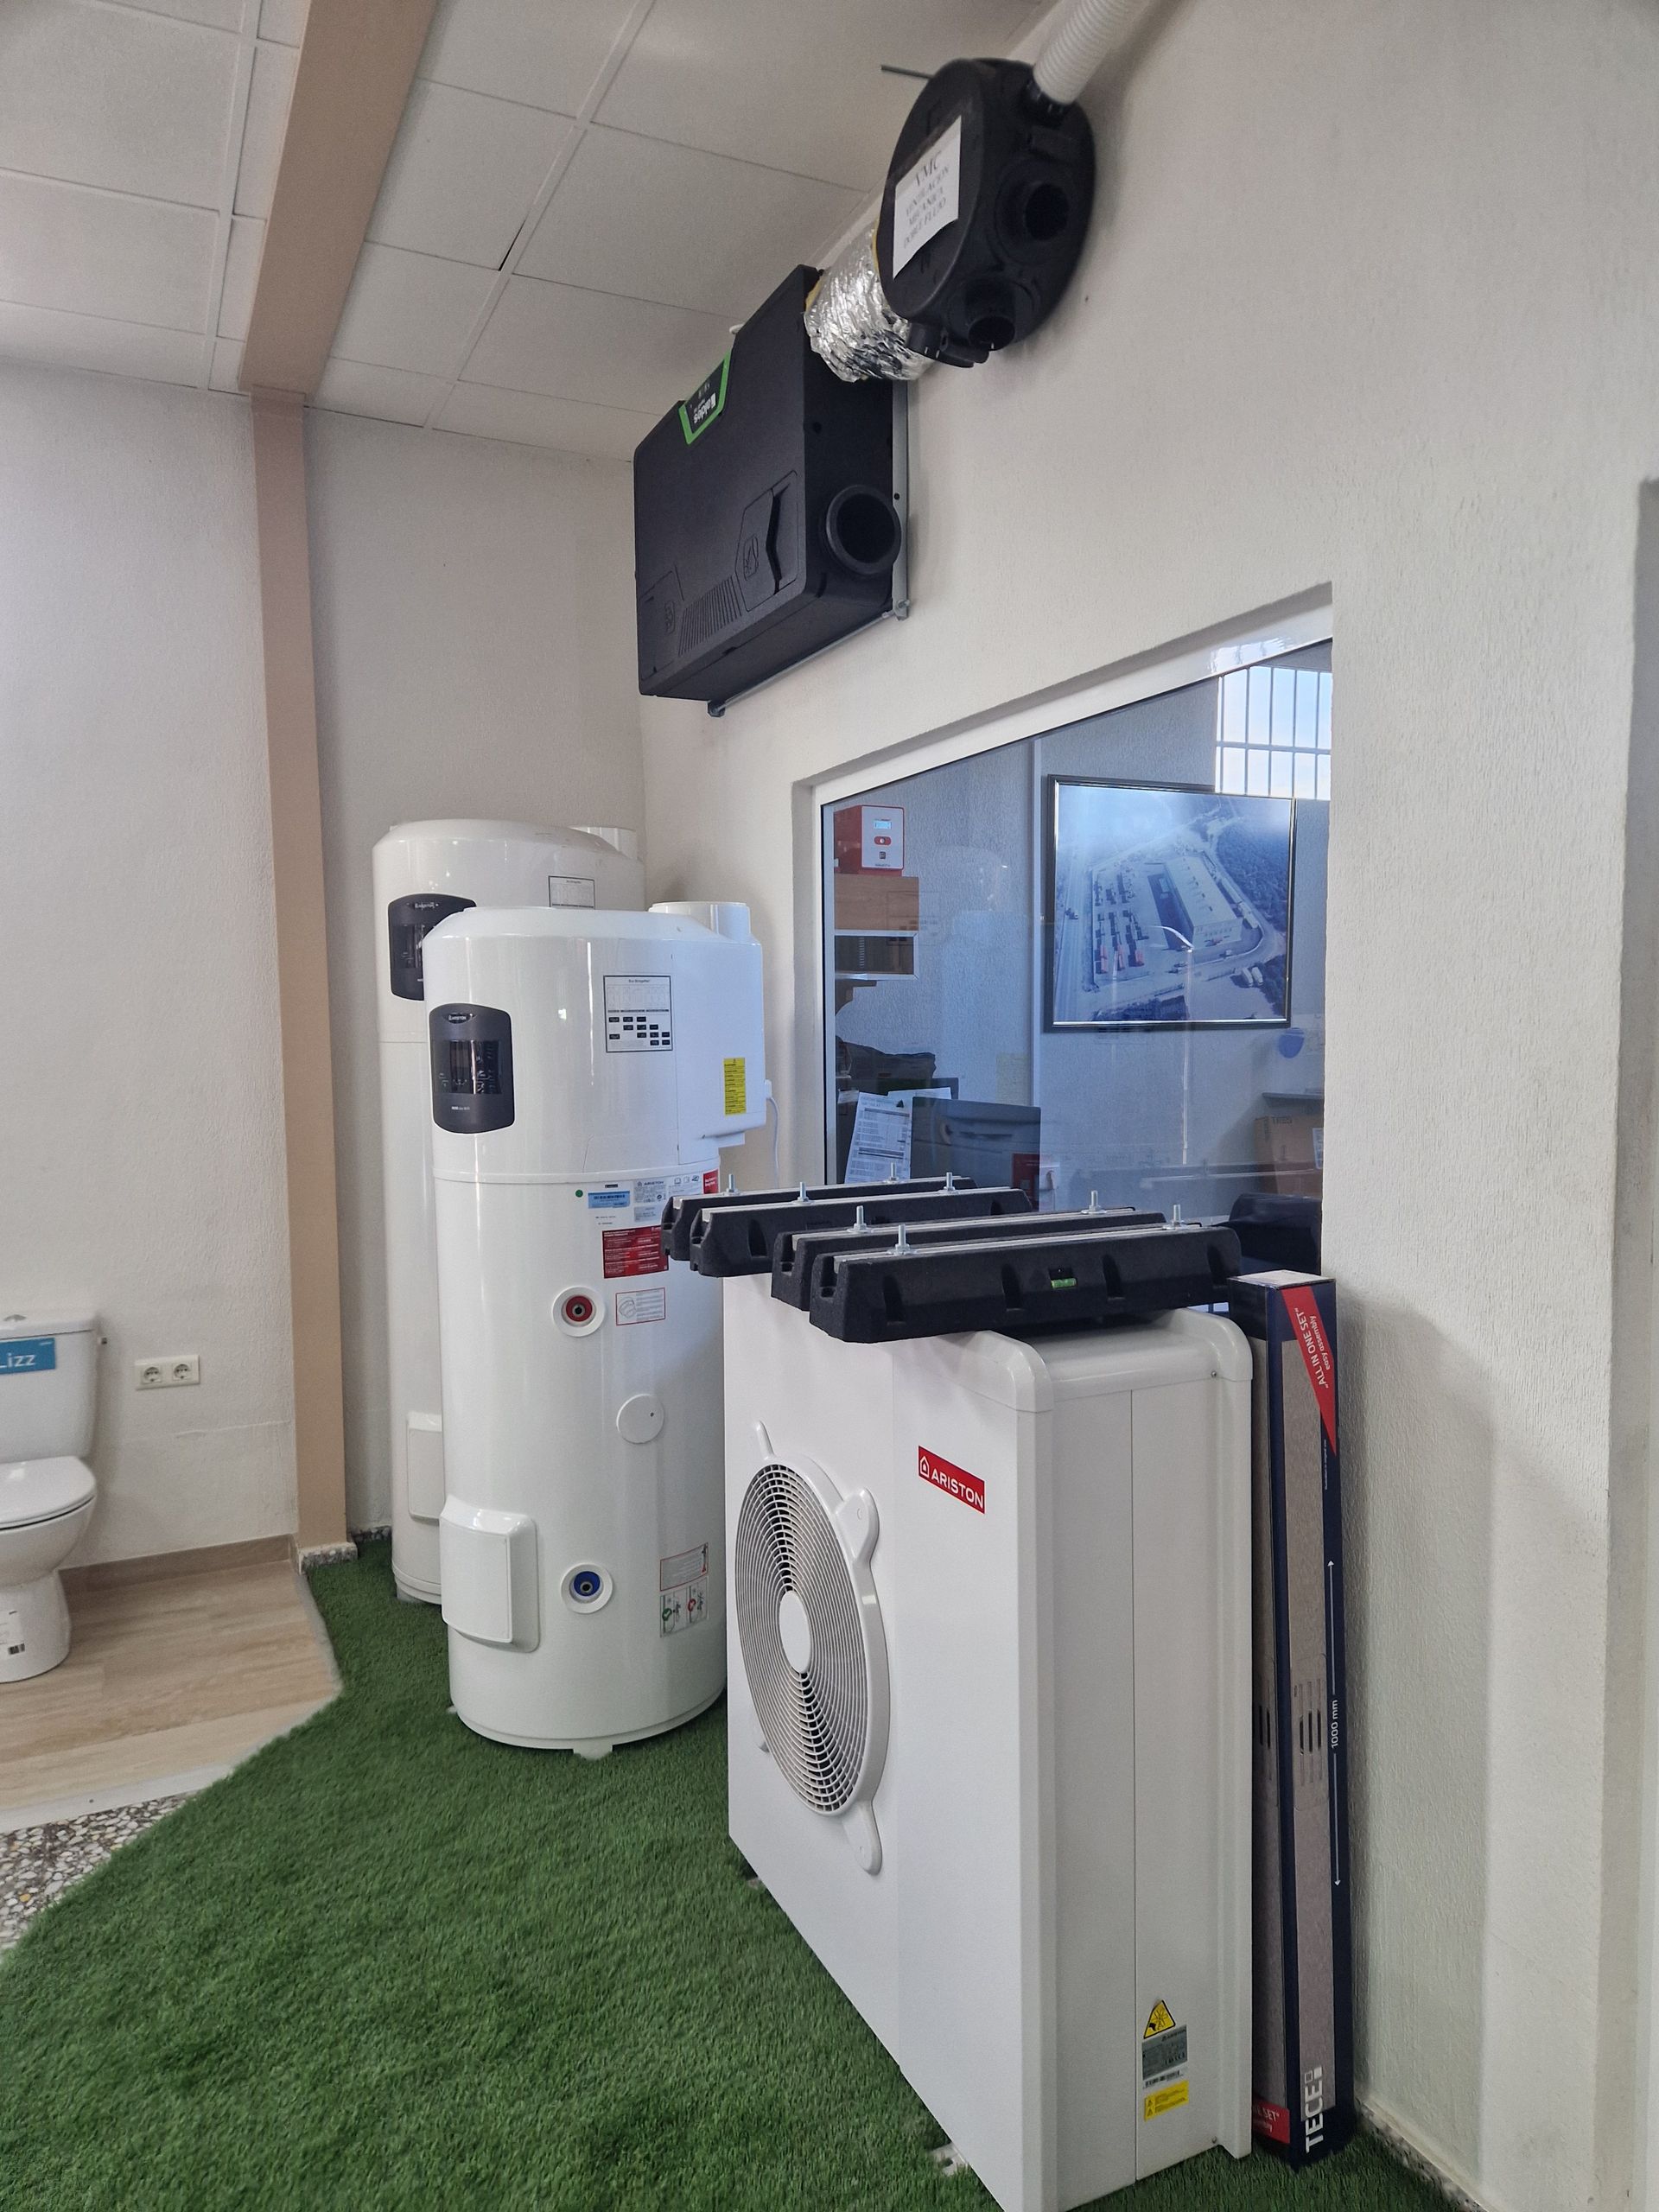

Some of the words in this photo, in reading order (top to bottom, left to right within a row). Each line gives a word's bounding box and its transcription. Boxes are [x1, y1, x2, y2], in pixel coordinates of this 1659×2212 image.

[1303, 1331, 1316, 1353] ONE
[1309, 1315, 1325, 1351] assembly
[1310, 1354, 1320, 1366] IN
[1321, 1351, 1331, 1370] easy
[931, 1468, 983, 1510] ARISTON
[1332, 1700, 1338, 1719] mm
[1305, 2080, 1324, 2154] TECE
